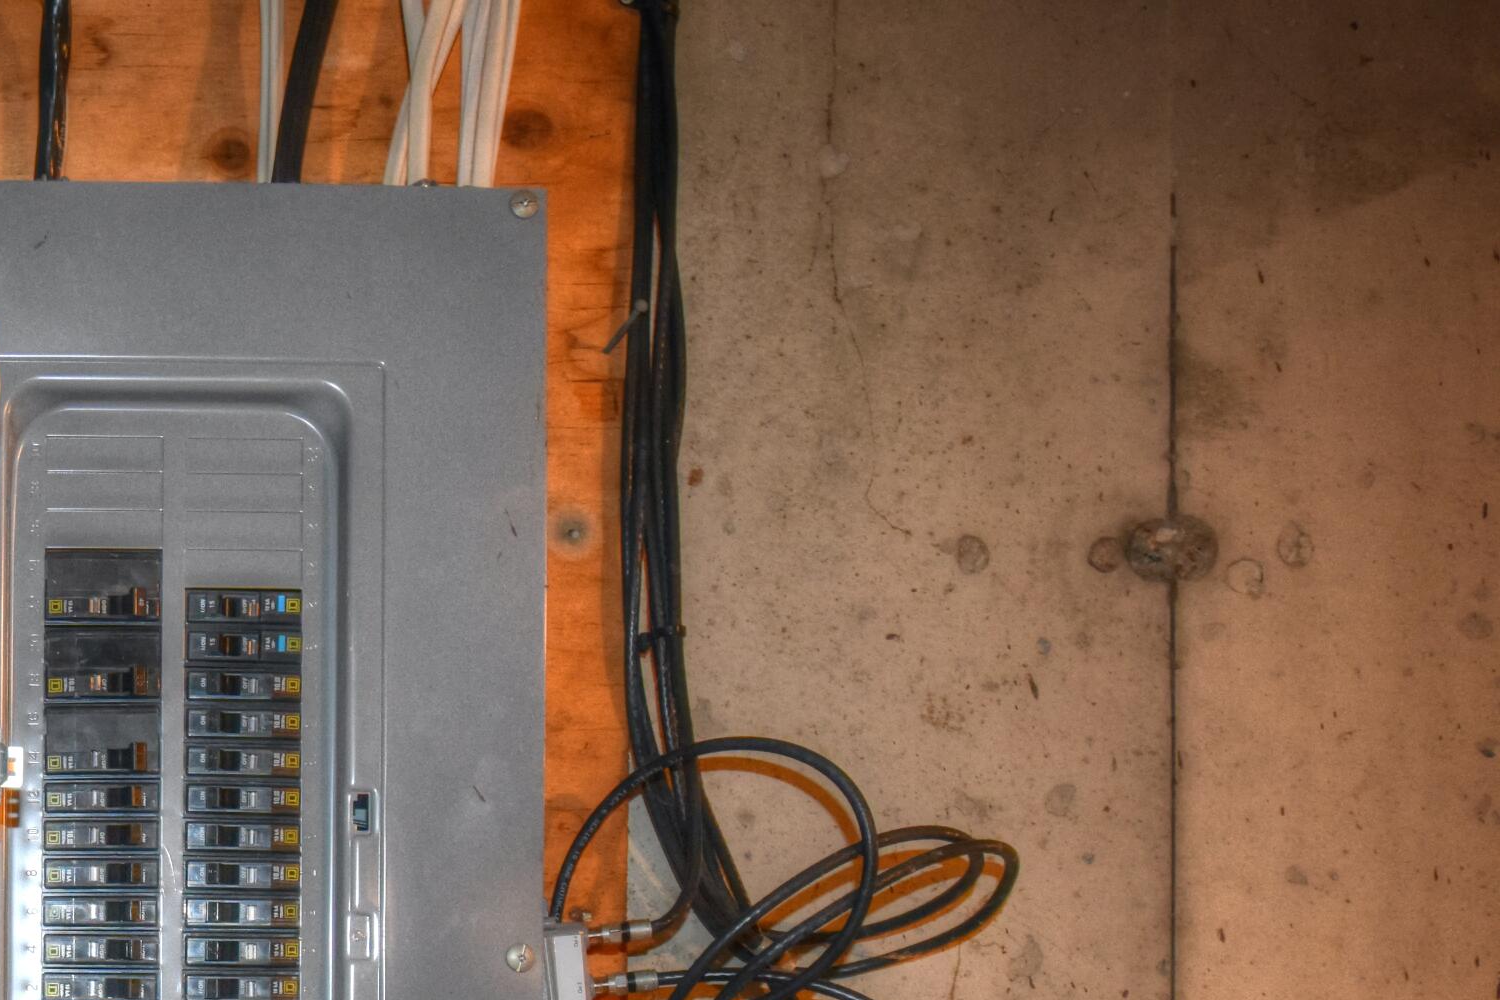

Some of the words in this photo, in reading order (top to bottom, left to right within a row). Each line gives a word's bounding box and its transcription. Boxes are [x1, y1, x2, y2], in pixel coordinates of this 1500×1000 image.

[26, 869, 37, 877] 8
[26, 944, 36, 954] 4
[27, 983, 38, 991] 2
